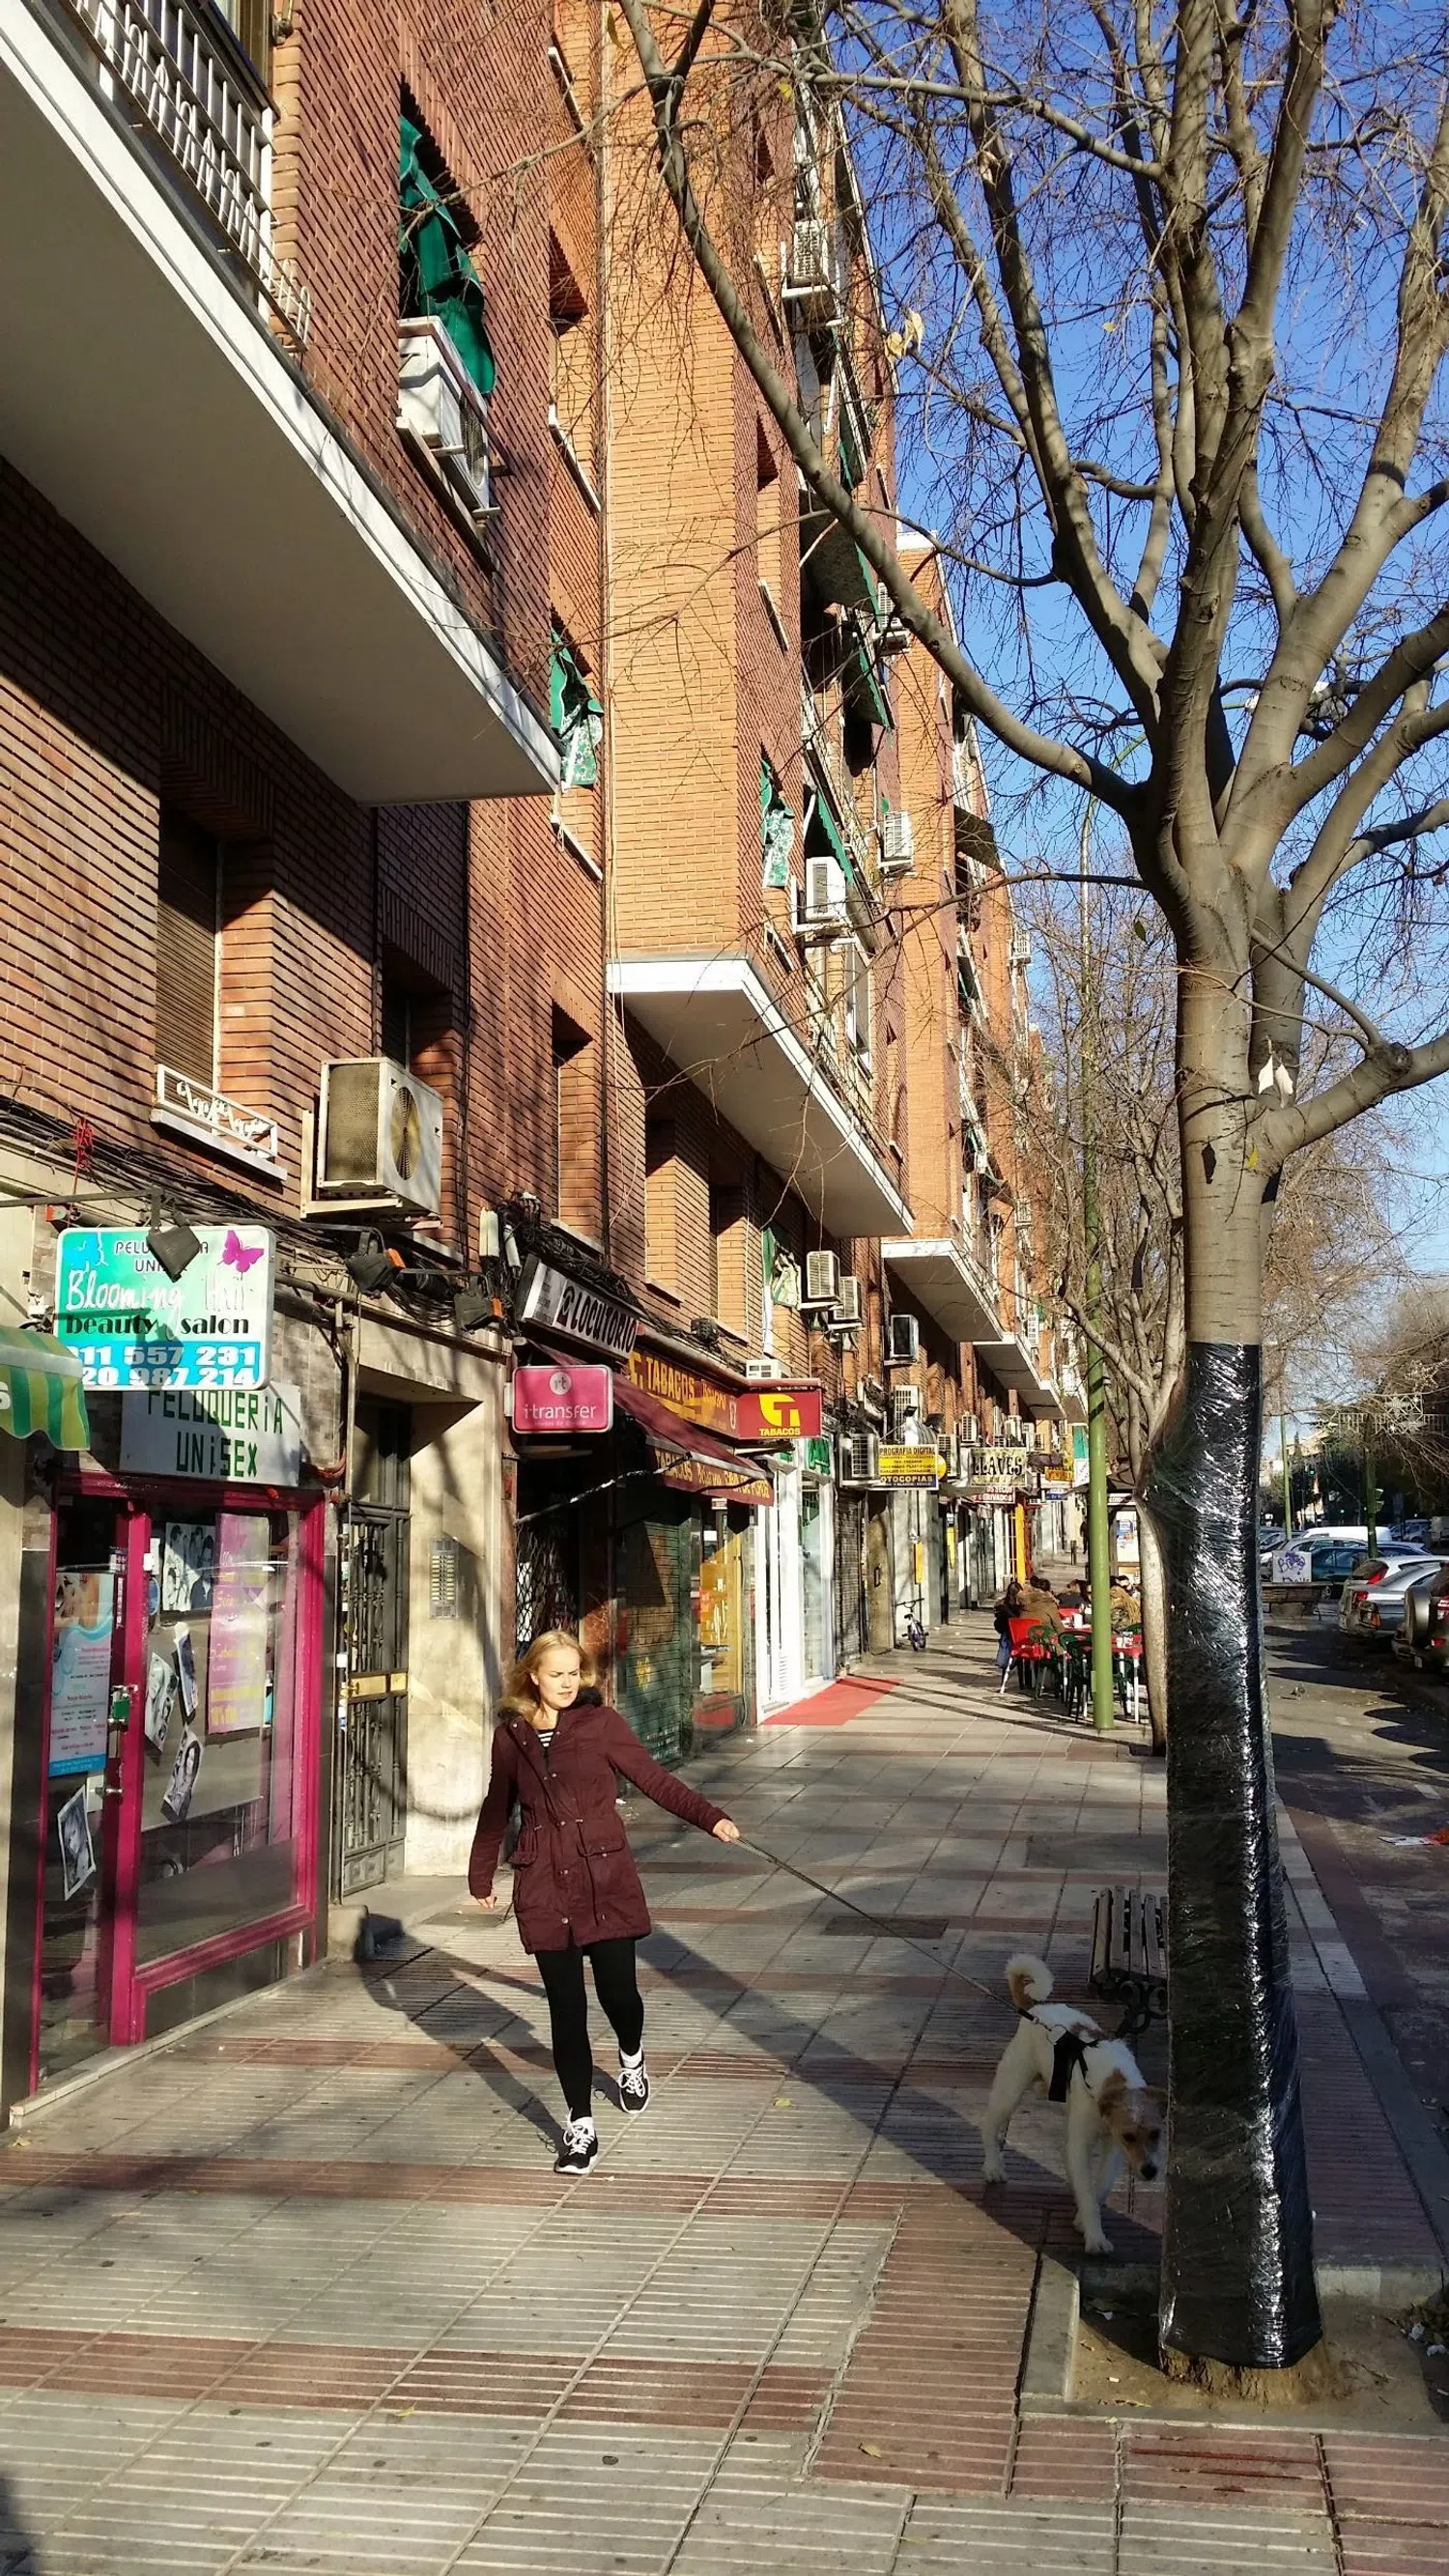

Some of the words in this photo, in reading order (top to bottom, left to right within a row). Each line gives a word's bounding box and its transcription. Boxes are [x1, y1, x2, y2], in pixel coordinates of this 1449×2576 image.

[114, 1241, 209, 1255] PELUA
[66, 1315, 158, 1334] beauty
[180, 1315, 249, 1334] salon
[570, 1291, 638, 1352] LOCUTORIO
[124, 1345, 183, 1365] 557
[195, 1345, 256, 1365] 231
[81, 1367, 119, 1385] 20
[128, 1367, 189, 1385] 987
[198, 1367, 259, 1385] 214
[646, 1356, 696, 1406] TABACOS
[759, 1428, 801, 1436] TABACOS
[879, 1447, 913, 1456] PROGRAFIA
[972, 1456, 1023, 1476] LLAVES
